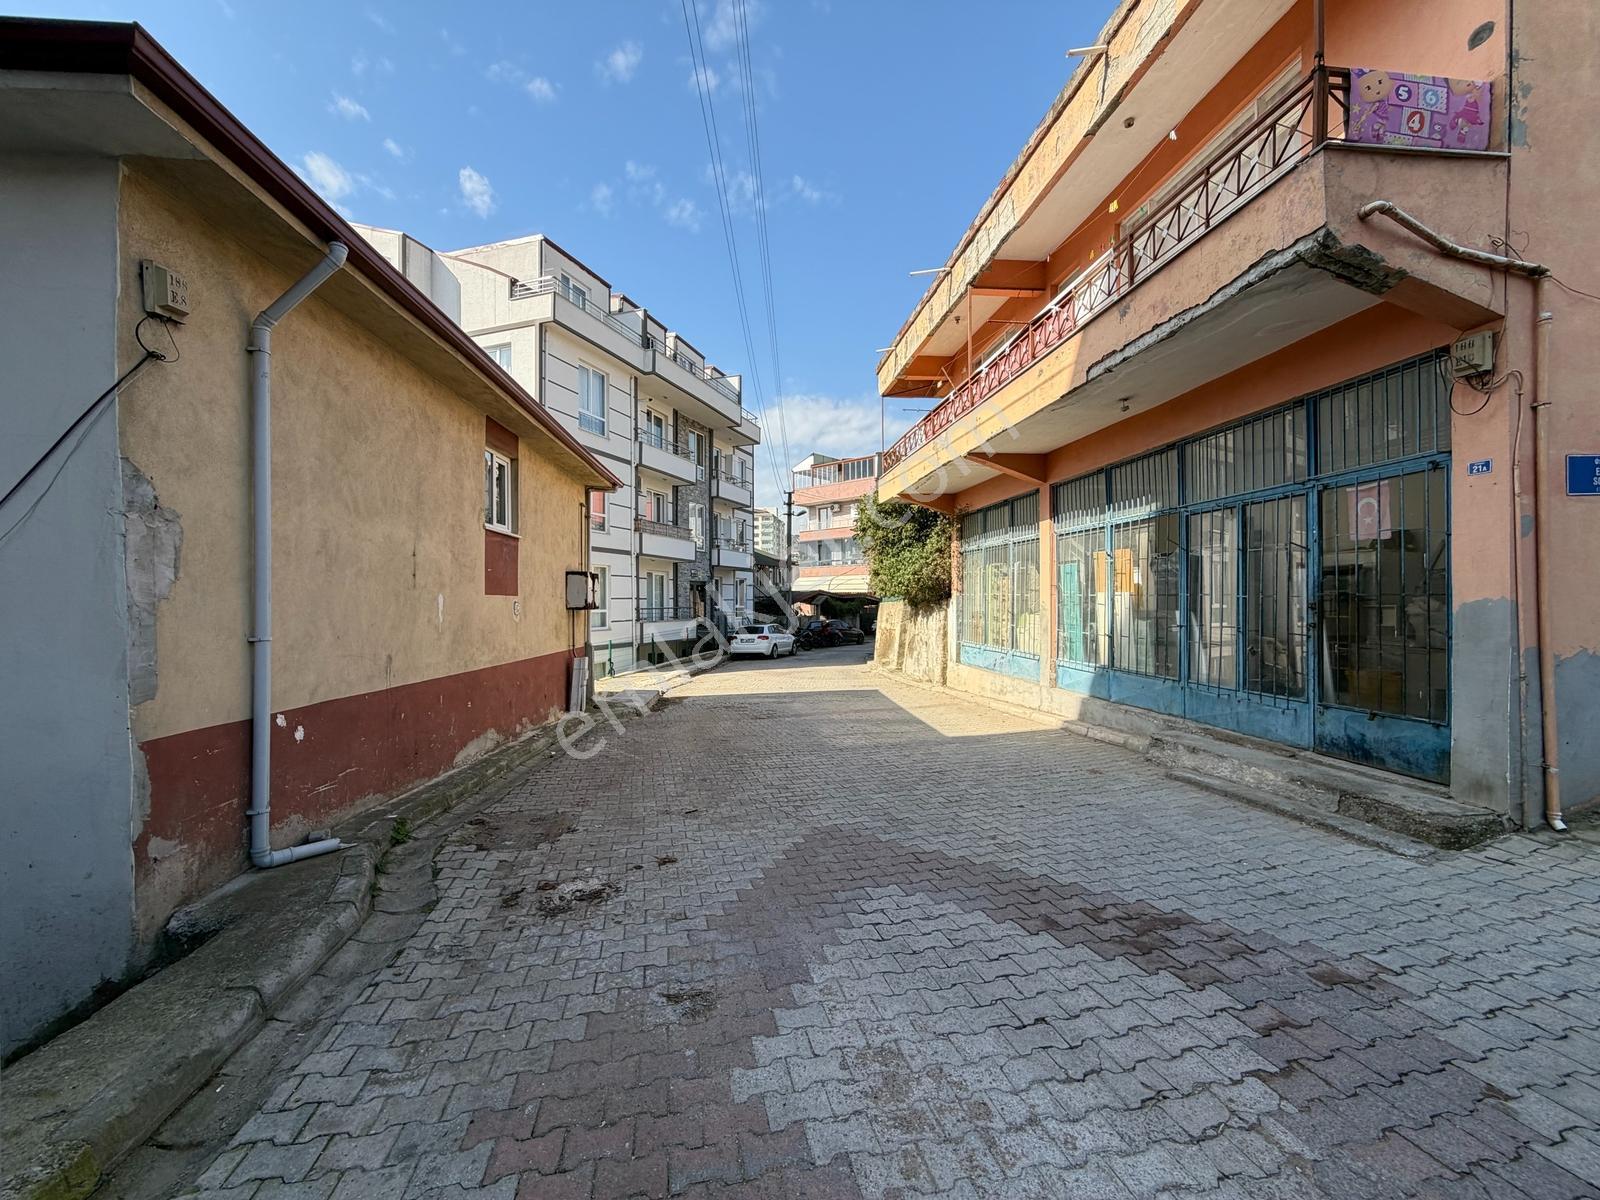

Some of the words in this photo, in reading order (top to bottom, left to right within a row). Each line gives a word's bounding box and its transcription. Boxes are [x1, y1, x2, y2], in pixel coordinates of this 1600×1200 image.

[1398, 87, 1409, 100] 5
[1425, 91, 1437, 103] 6
[1408, 113, 1420, 131] 4
